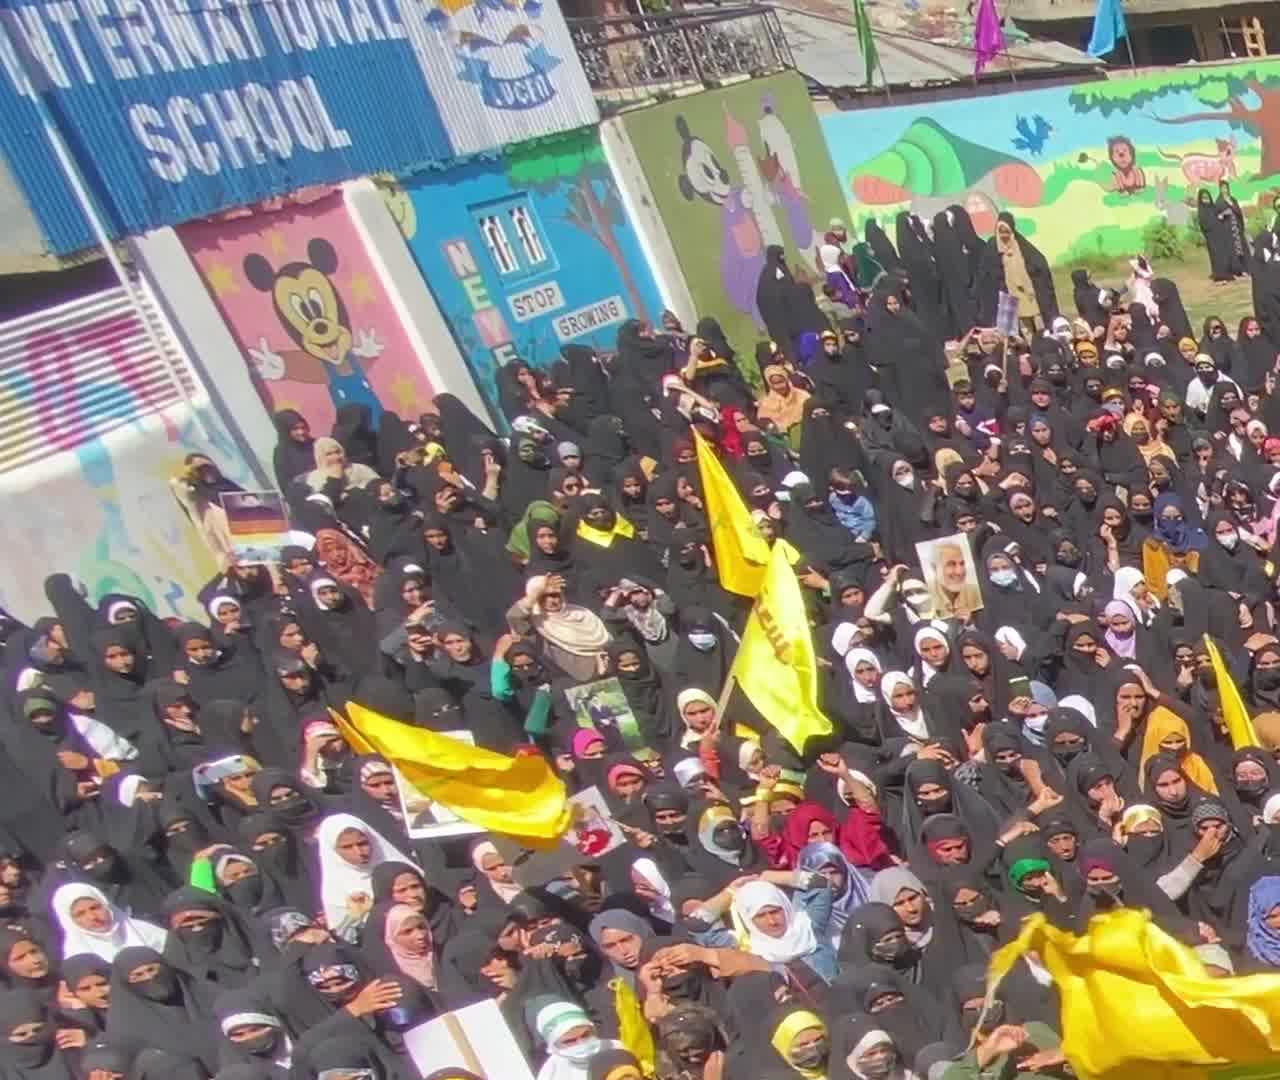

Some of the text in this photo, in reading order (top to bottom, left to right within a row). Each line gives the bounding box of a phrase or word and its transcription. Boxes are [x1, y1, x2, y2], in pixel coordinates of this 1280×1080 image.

[130, 75, 352, 183] SCHOOL
[513, 287, 555, 317] STOP
[558, 300, 619, 336] GROWING
